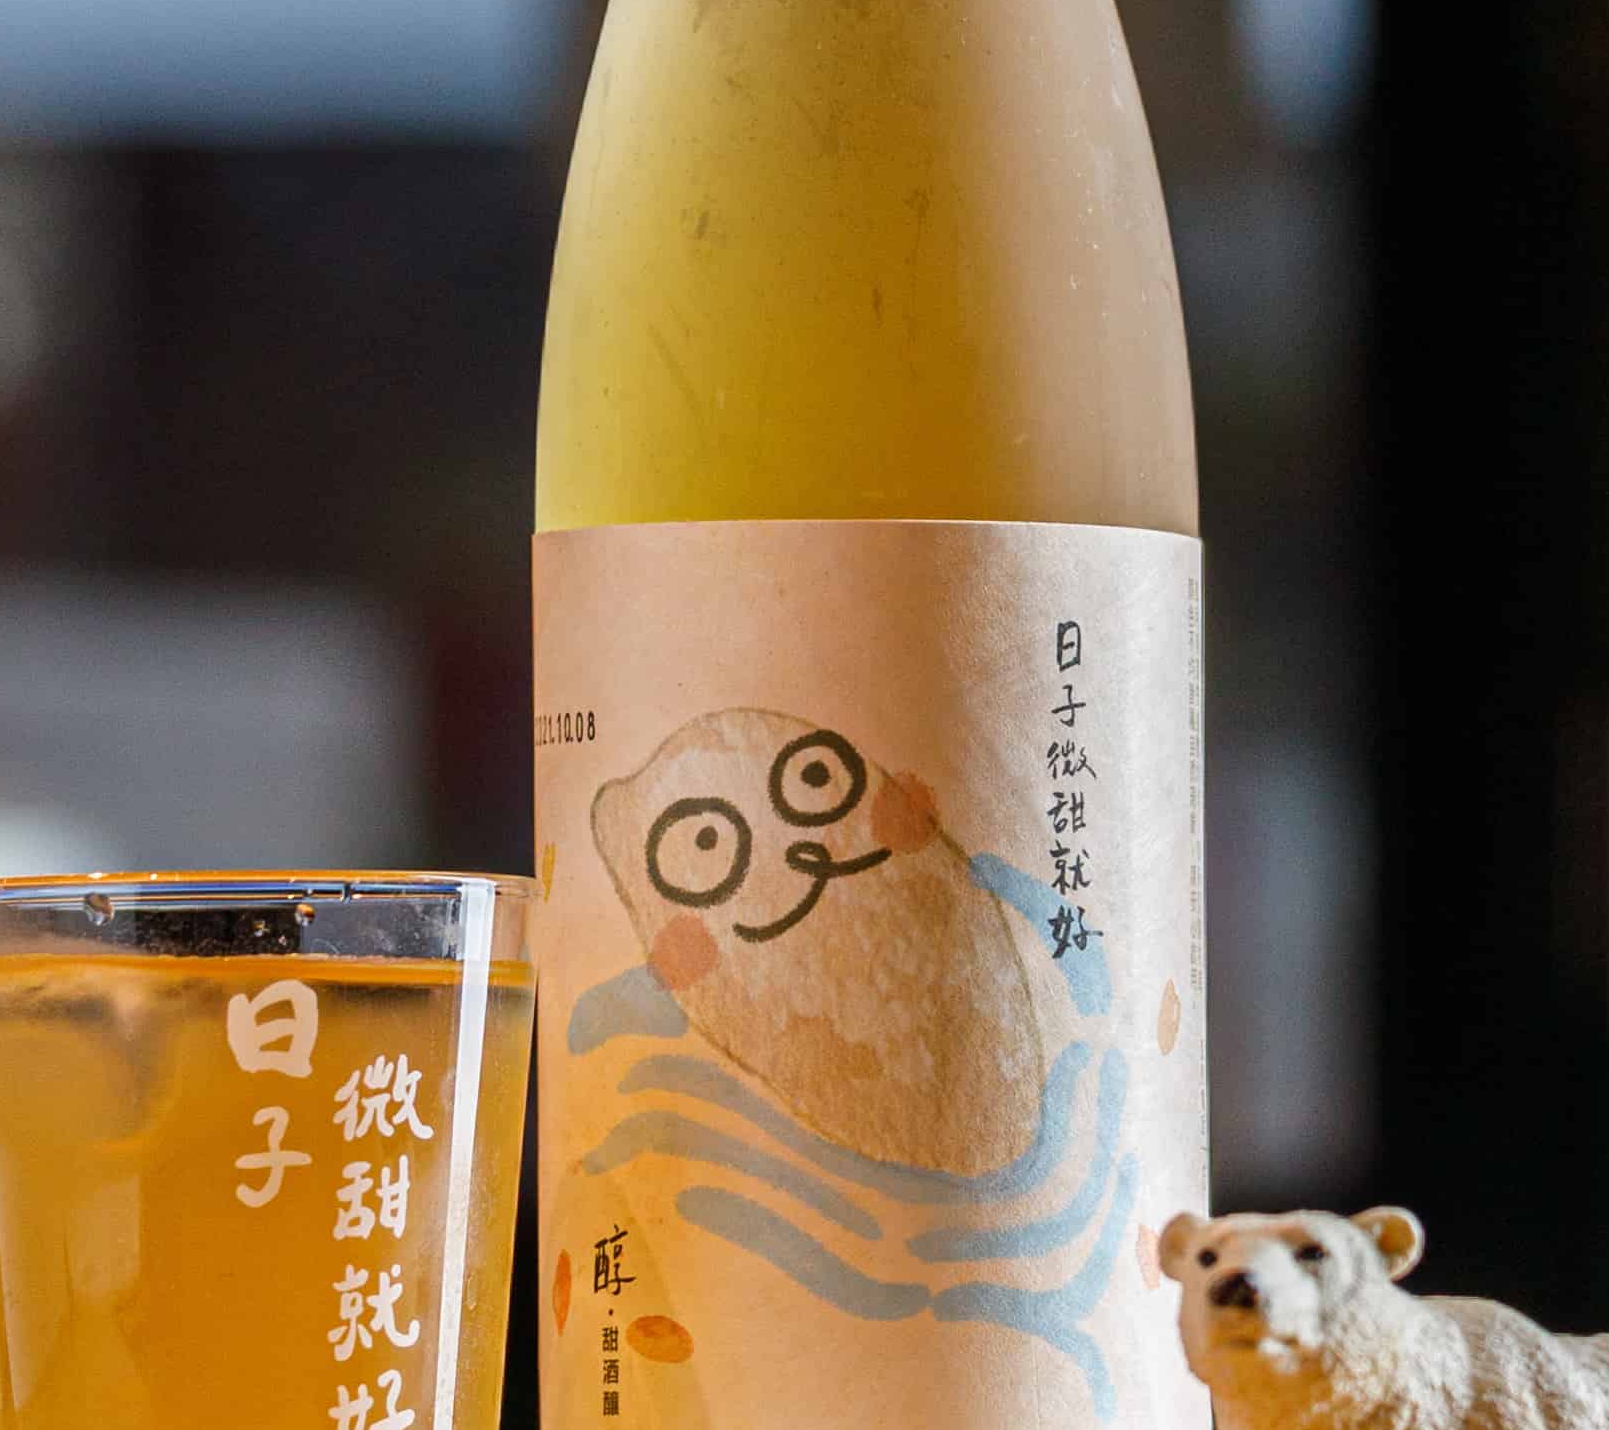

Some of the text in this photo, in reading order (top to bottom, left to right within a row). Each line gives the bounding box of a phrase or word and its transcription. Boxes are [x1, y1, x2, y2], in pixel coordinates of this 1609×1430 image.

[1045, 620, 1103, 959] 日子微甜就好
[226, 979, 318, 1208] 日子
